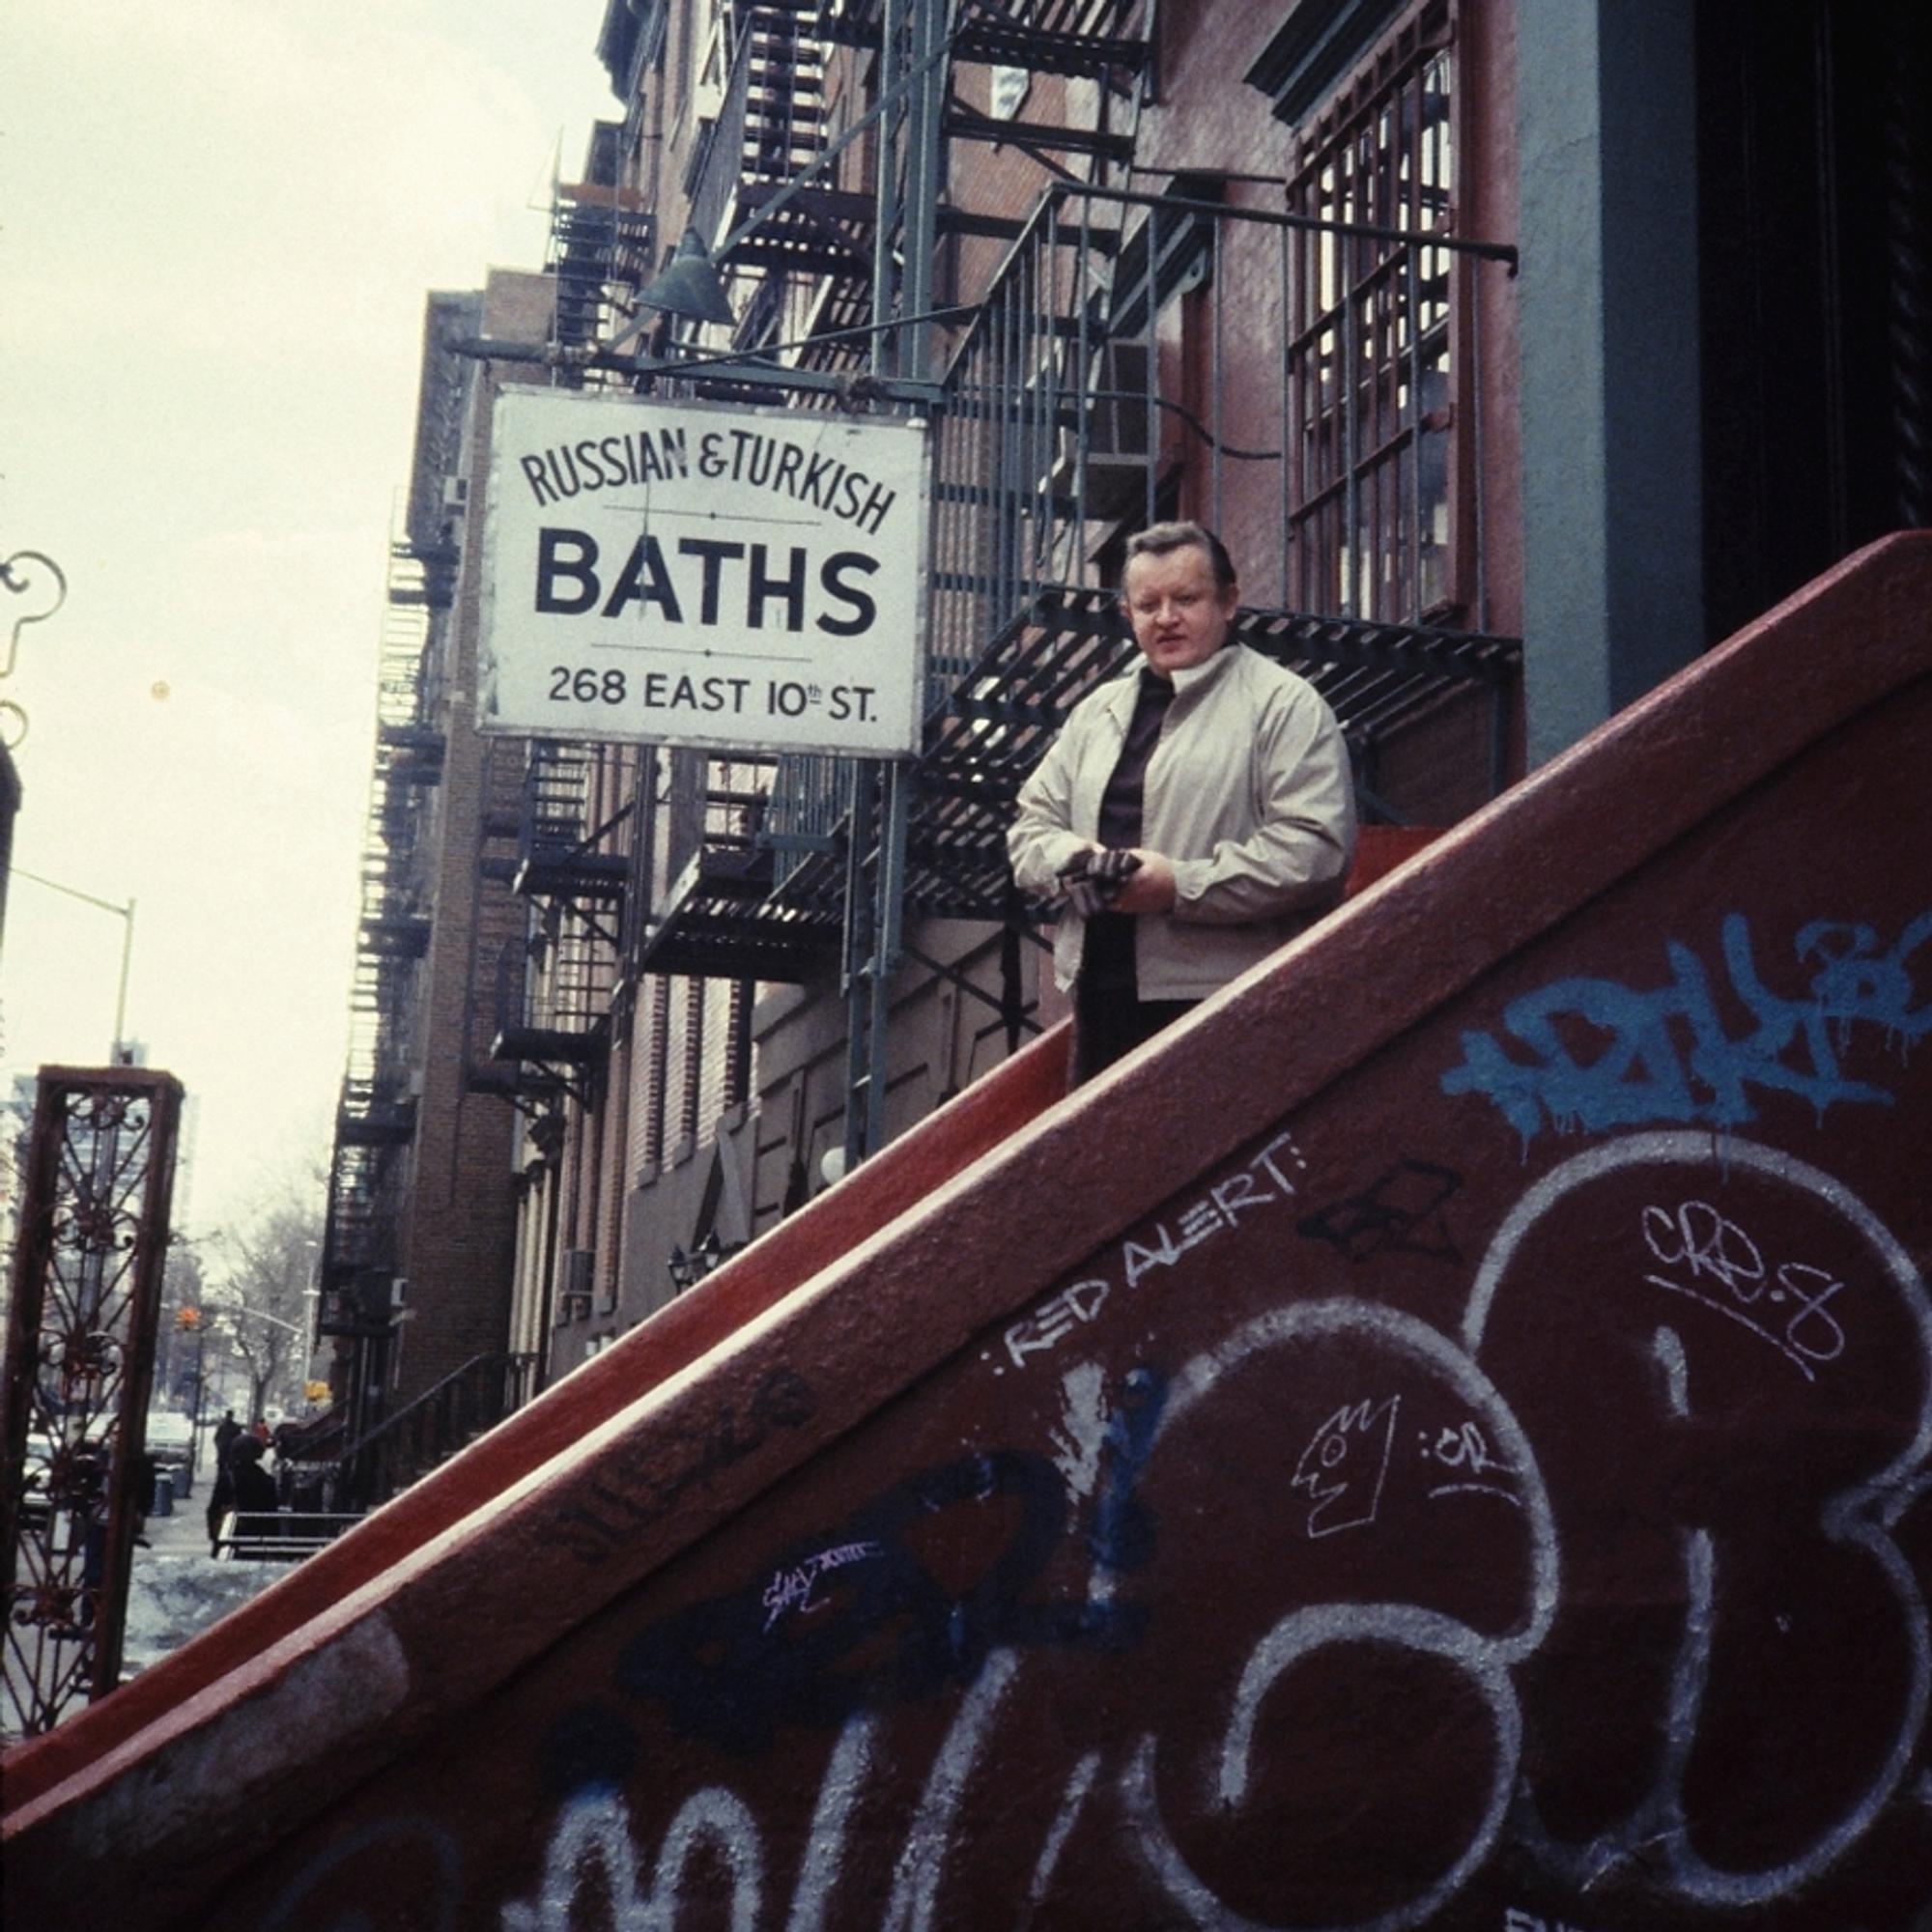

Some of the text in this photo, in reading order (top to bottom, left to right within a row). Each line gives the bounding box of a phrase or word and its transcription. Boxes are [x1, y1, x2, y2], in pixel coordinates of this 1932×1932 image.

[520, 427, 895, 535] RUSSIAN & TURKISH
[535, 526, 881, 637] BATHS
[549, 666, 627, 705] 268
[644, 673, 750, 713] EAST
[828, 686, 878, 723] ST.
